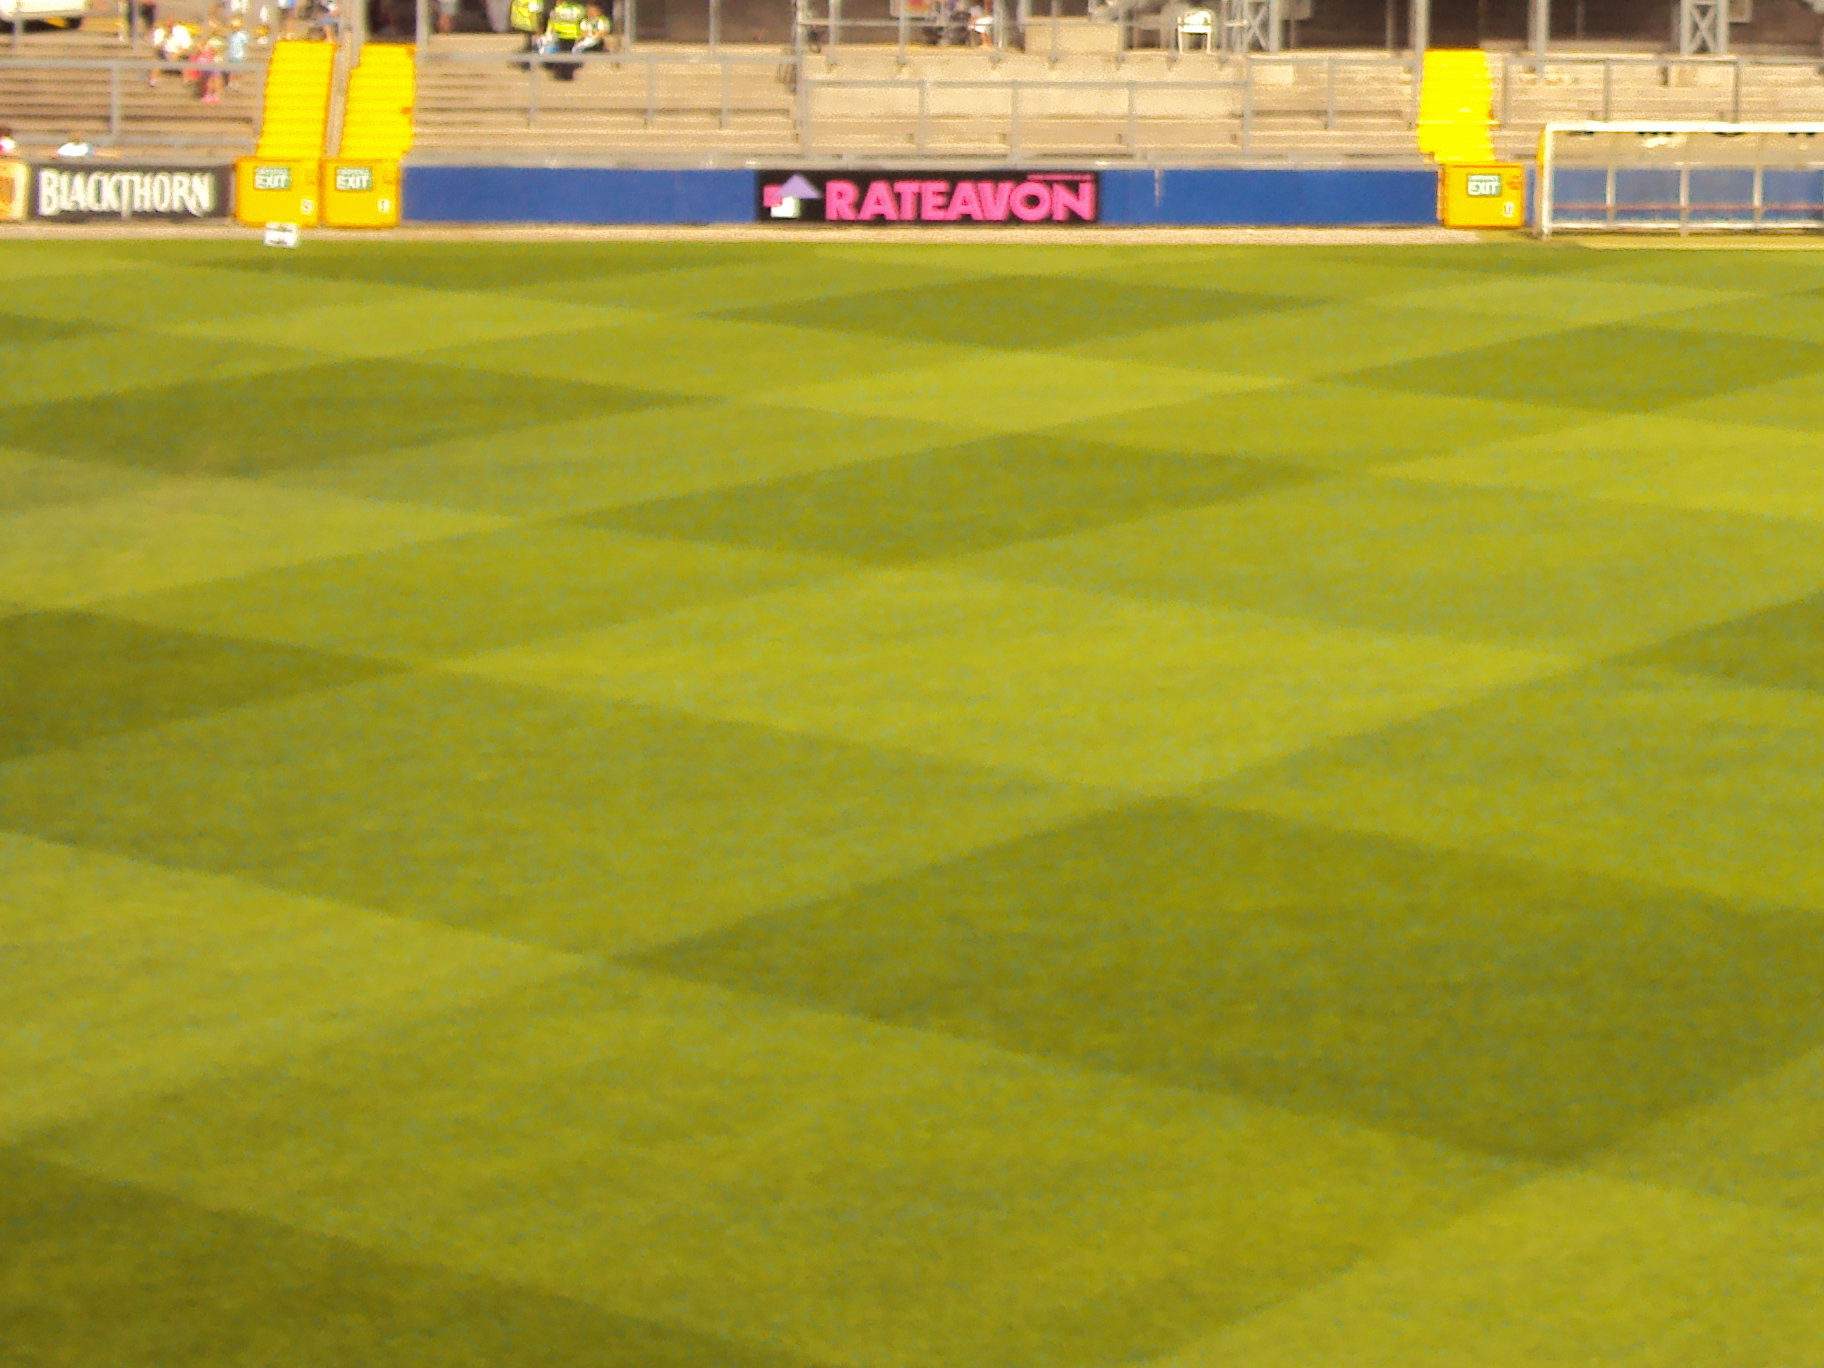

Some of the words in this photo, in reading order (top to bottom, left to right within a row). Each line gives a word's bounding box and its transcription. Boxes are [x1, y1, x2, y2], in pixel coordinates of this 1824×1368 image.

[255, 174, 289, 189] EXIT
[336, 175, 371, 190] EXIT
[1467, 181, 1500, 195] EXIT
[37, 168, 215, 219] BLACKTHORN
[825, 179, 1096, 222] RATEAVON
